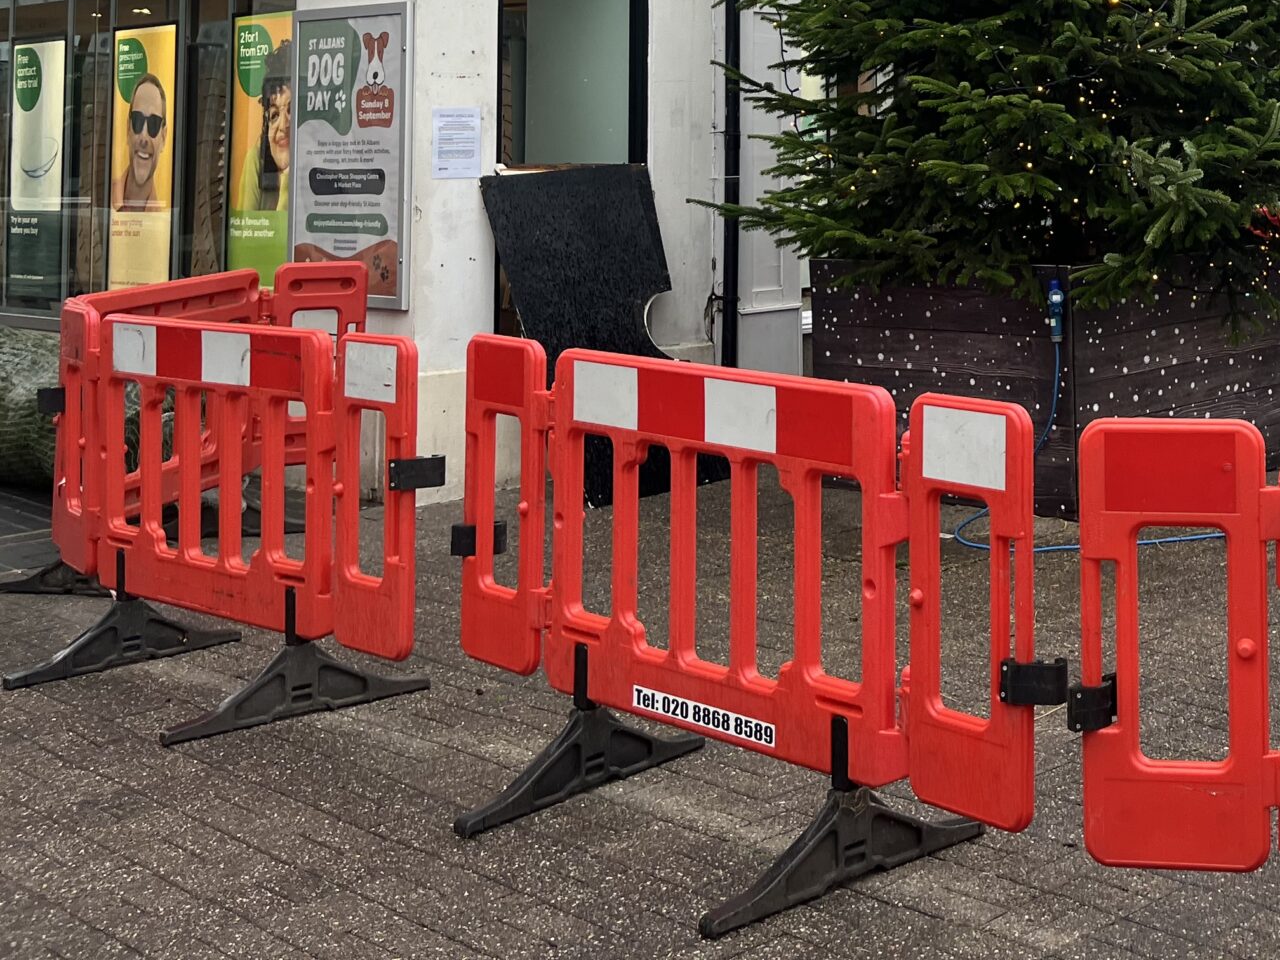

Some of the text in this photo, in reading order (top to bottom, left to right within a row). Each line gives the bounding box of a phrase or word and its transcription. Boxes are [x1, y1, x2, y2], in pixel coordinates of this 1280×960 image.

[240, 32, 245, 44] 2
[308, 37, 346, 50] ST ALBANS
[240, 44, 269, 58] from £70
[17, 54, 29, 65] Free
[16, 66, 37, 77] contact
[307, 52, 345, 88] DOG
[306, 90, 332, 112] DAY
[360, 99, 384, 111] Sunday
[358, 111, 392, 122] September
[230, 216, 241, 226] Pick
[230, 228, 242, 237] Then
[253, 229, 276, 238] another
[635, 687, 774, 745] Tel: 020 8868 8589
